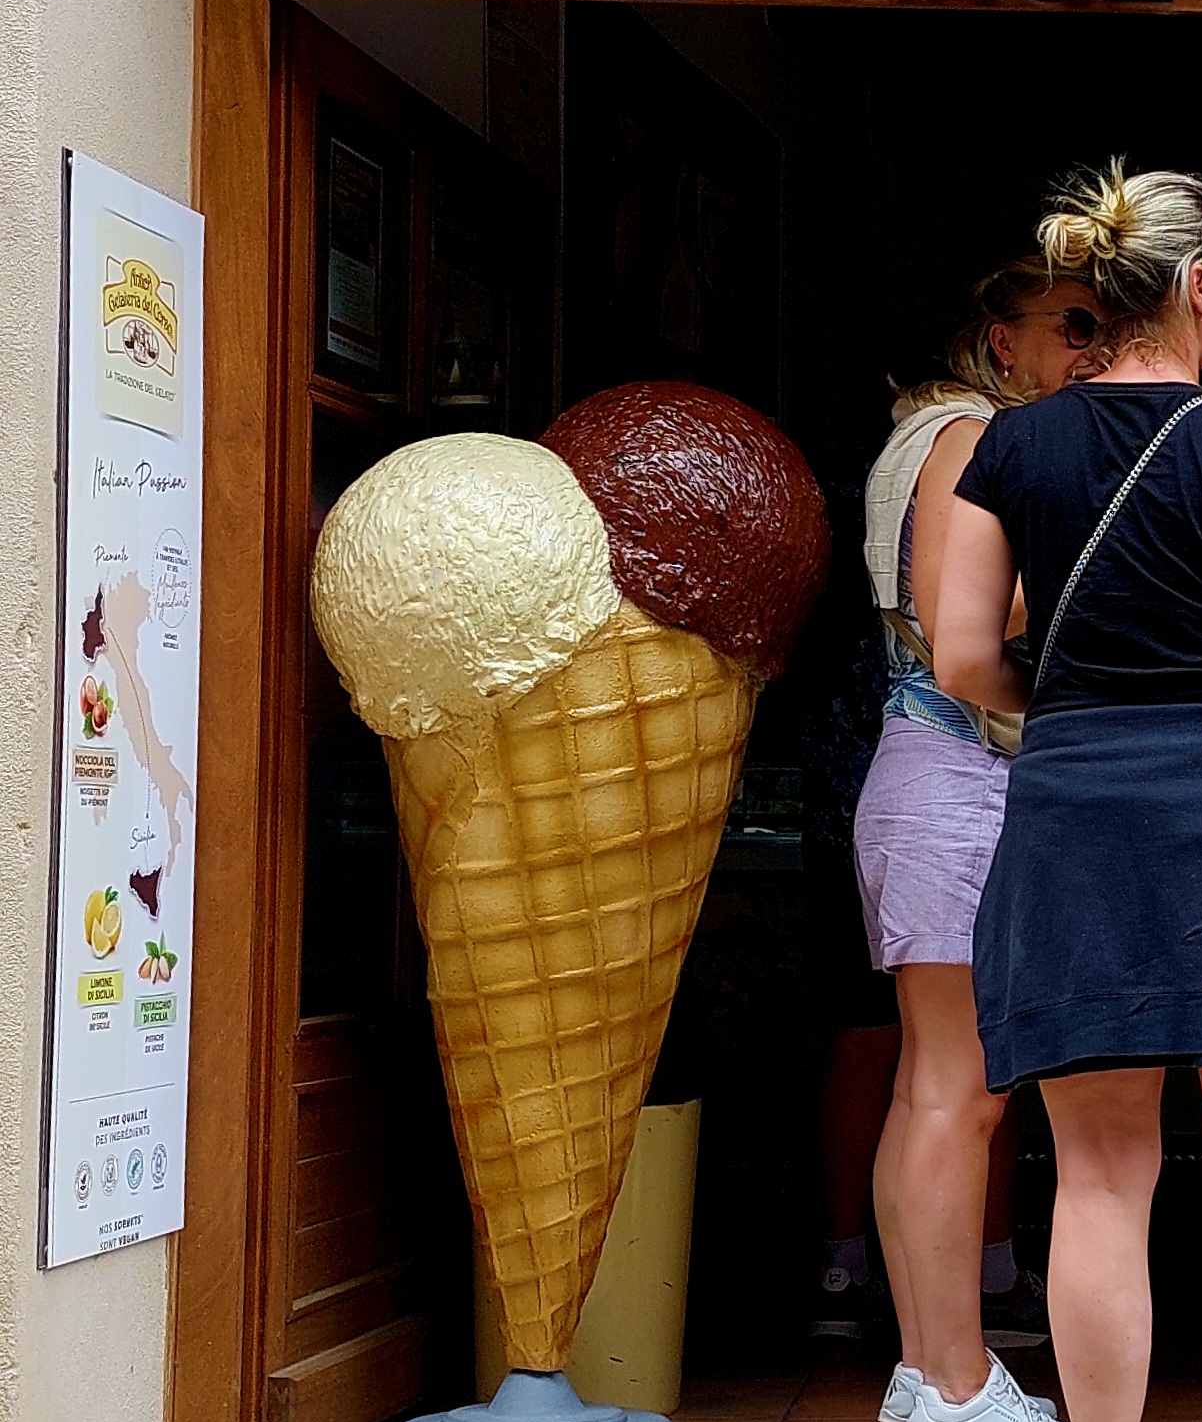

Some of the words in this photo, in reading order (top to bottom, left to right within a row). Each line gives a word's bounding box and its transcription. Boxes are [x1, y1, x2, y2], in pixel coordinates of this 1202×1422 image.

[93, 457, 133, 498] Italian
[134, 460, 187, 496] Passion
[75, 754, 104, 767] NOCCIOLA
[90, 977, 114, 988] LIMONE
[87, 991, 94, 1001] DI
[95, 989, 114, 1001] SICILIA
[98, 1115, 120, 1128] HAUTE
[121, 1107, 149, 1124] QUALITÉ
[95, 1133, 108, 1147] DES
[109, 1125, 151, 1142] INGRÉDIENTS
[99, 1237, 117, 1251] SONT
